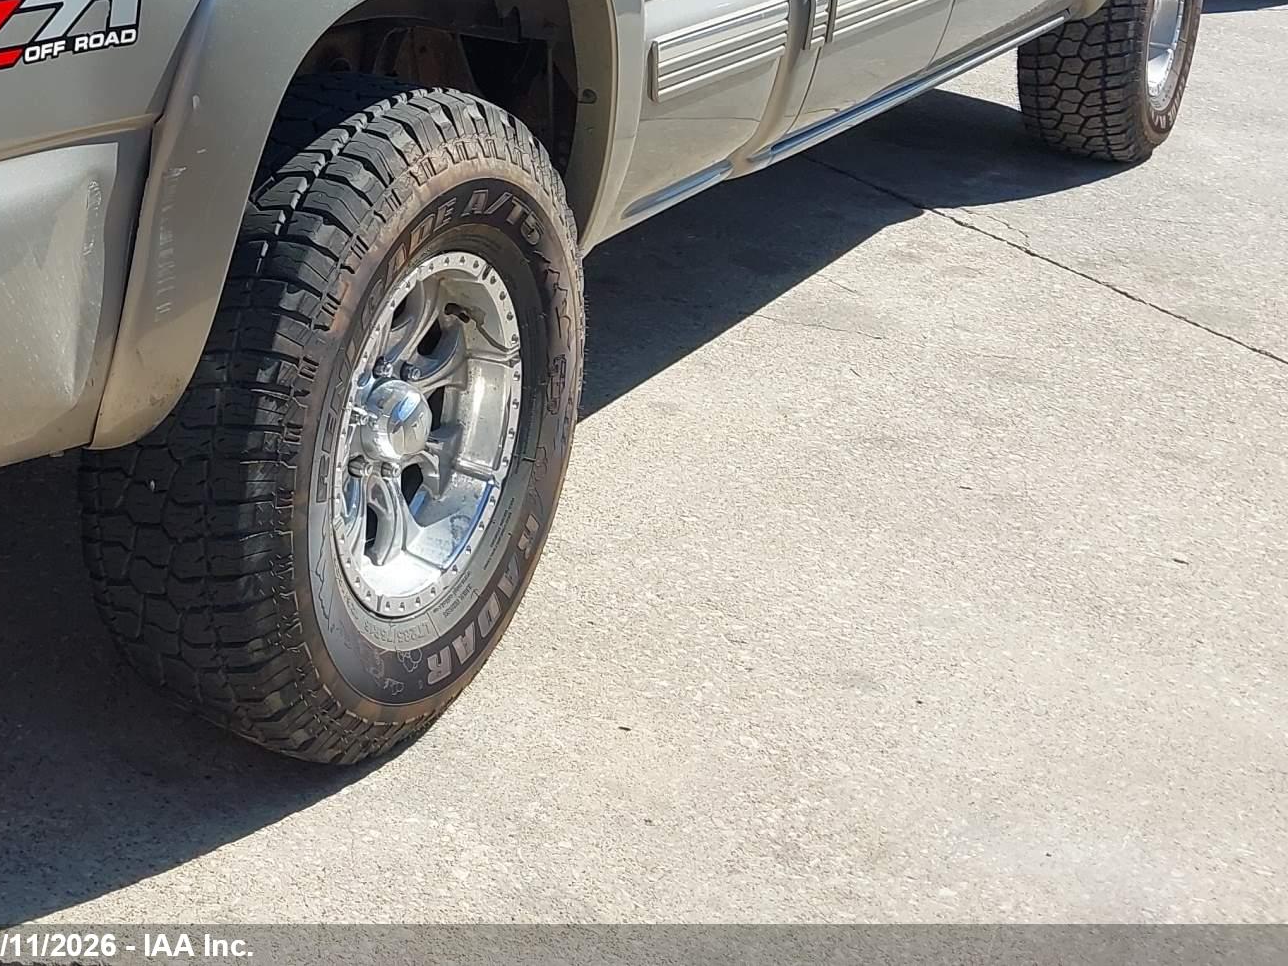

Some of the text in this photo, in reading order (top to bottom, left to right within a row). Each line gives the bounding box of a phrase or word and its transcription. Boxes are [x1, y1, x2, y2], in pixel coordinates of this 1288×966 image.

[23, 28, 137, 63] OFF ROAD
[426, 513, 541, 686] RADAR
